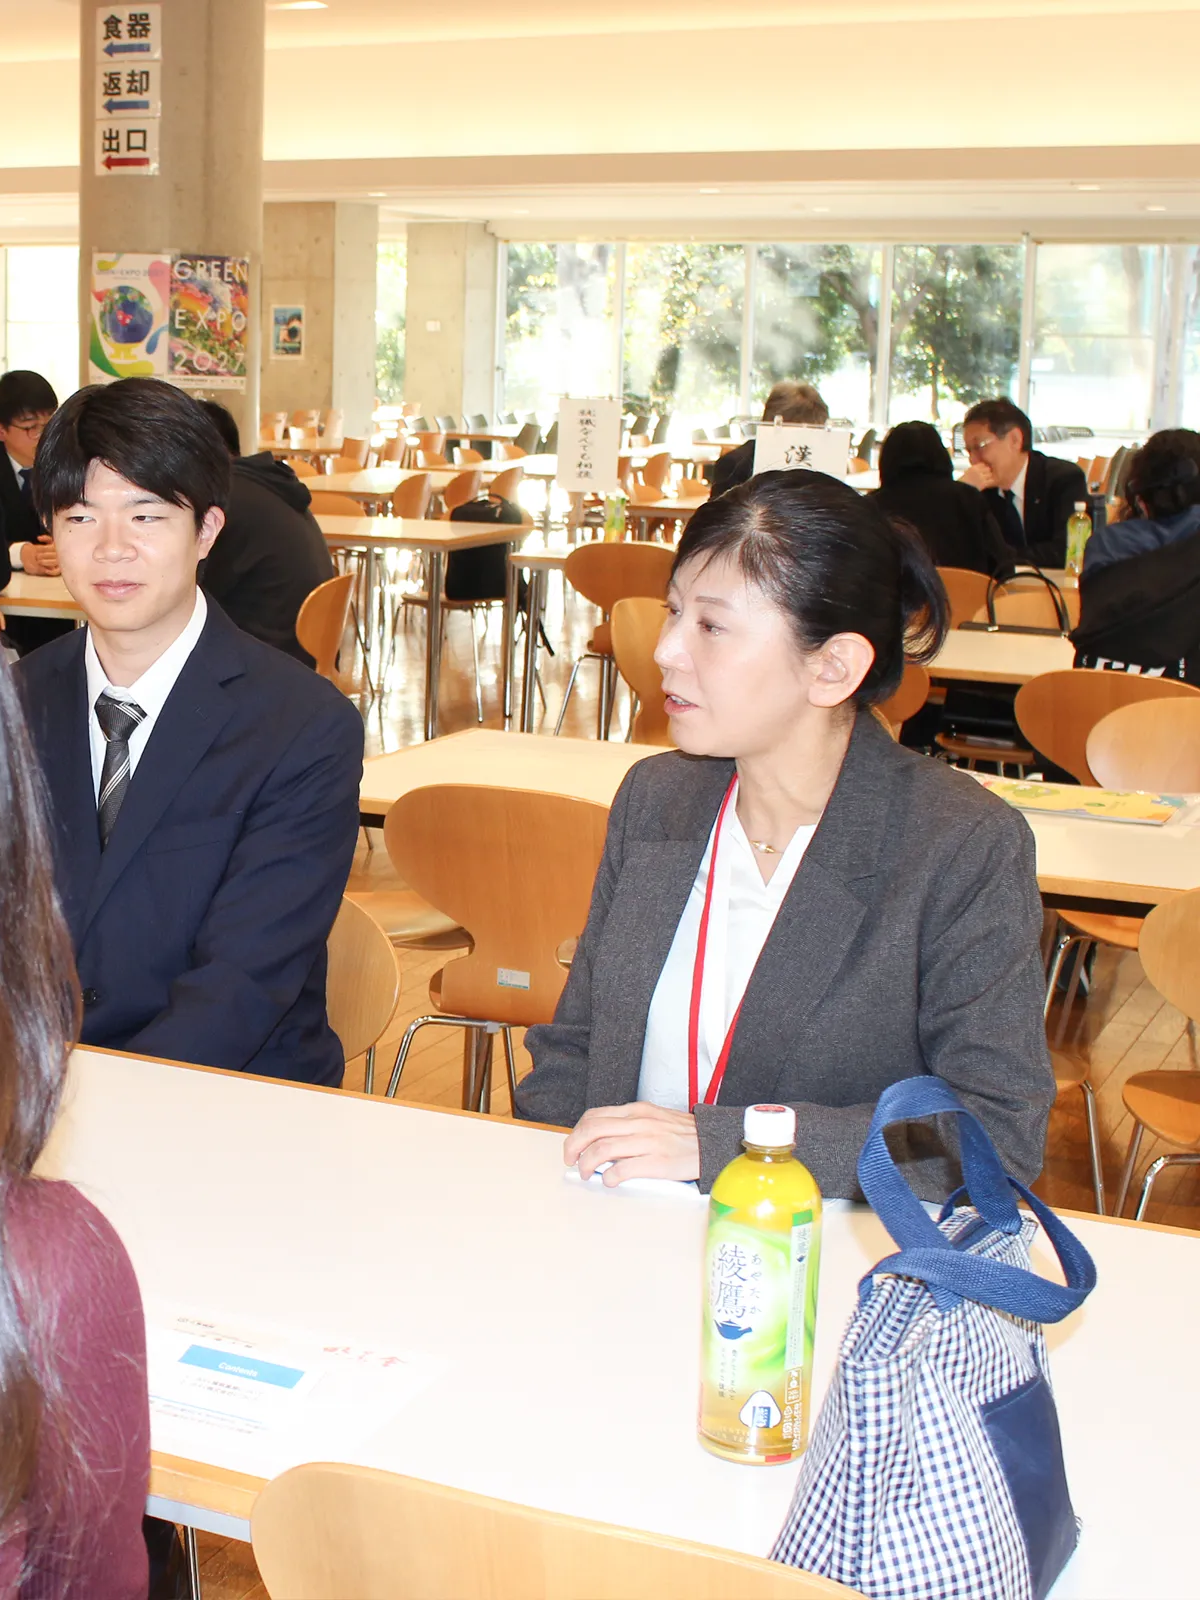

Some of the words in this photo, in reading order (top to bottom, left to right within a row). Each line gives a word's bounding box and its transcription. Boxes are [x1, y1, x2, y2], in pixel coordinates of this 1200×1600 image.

[103, 12, 151, 41] 食器
[102, 70, 150, 97] 返却
[102, 127, 148, 154] 出口
[173, 258, 248, 282] GREEN
[175, 308, 246, 332] EXPO
[174, 350, 245, 371] 2027
[715, 1243, 748, 1319] 綾鷹
[748, 1253, 763, 1315] あやたか
[217, 1361, 259, 1378] Contents
